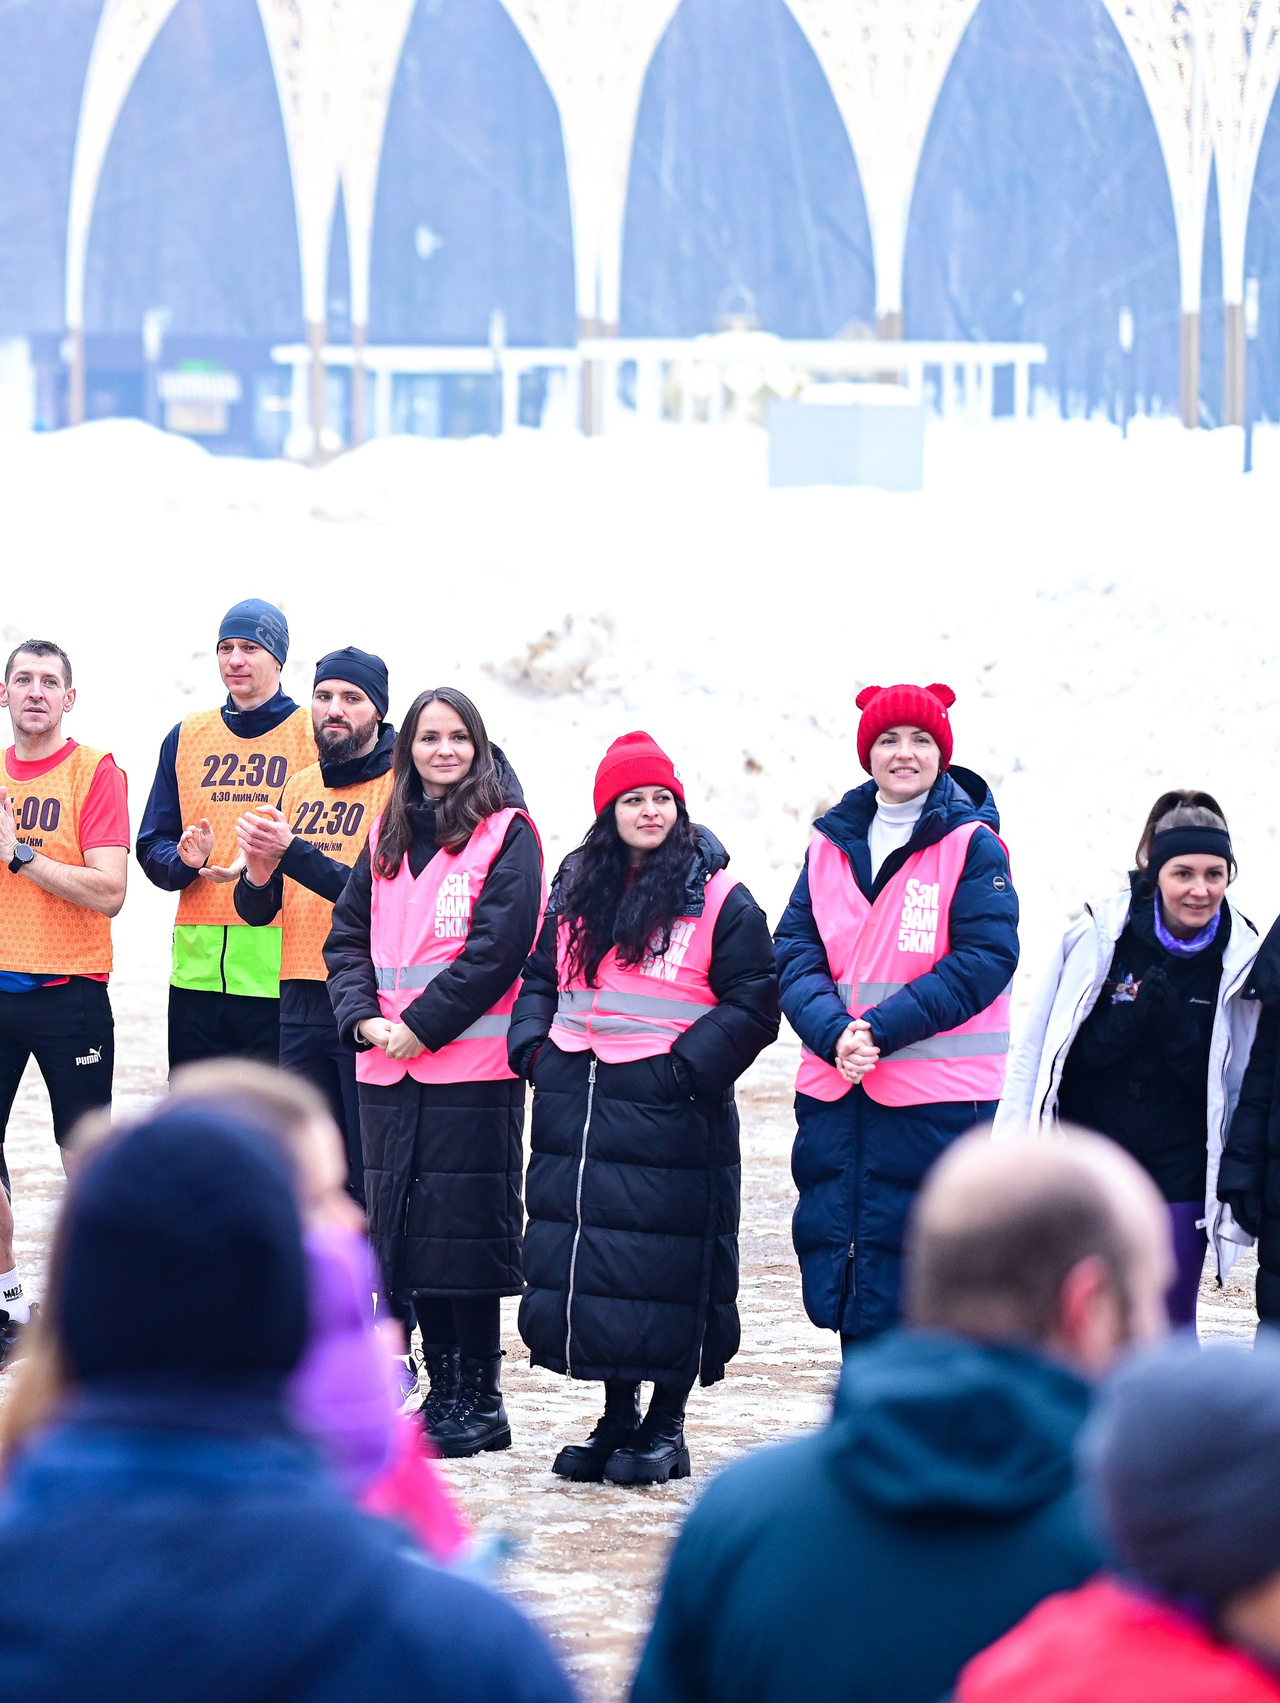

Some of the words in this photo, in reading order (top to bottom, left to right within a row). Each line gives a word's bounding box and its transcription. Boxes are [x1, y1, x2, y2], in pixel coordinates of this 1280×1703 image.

[201, 753, 287, 788] 22:30
[211, 791, 230, 802] 4:30
[232, 792, 269, 803] мин/км
[291, 801, 365, 836] 22:30
[439, 872, 470, 897] Sat
[905, 878, 940, 910] Sat
[435, 896, 470, 918] 9AM
[900, 906, 938, 932] 9AM
[434, 917, 469, 939] 5KM
[898, 928, 936, 954] 5KM
[75, 1054, 99, 1066] PUMA
